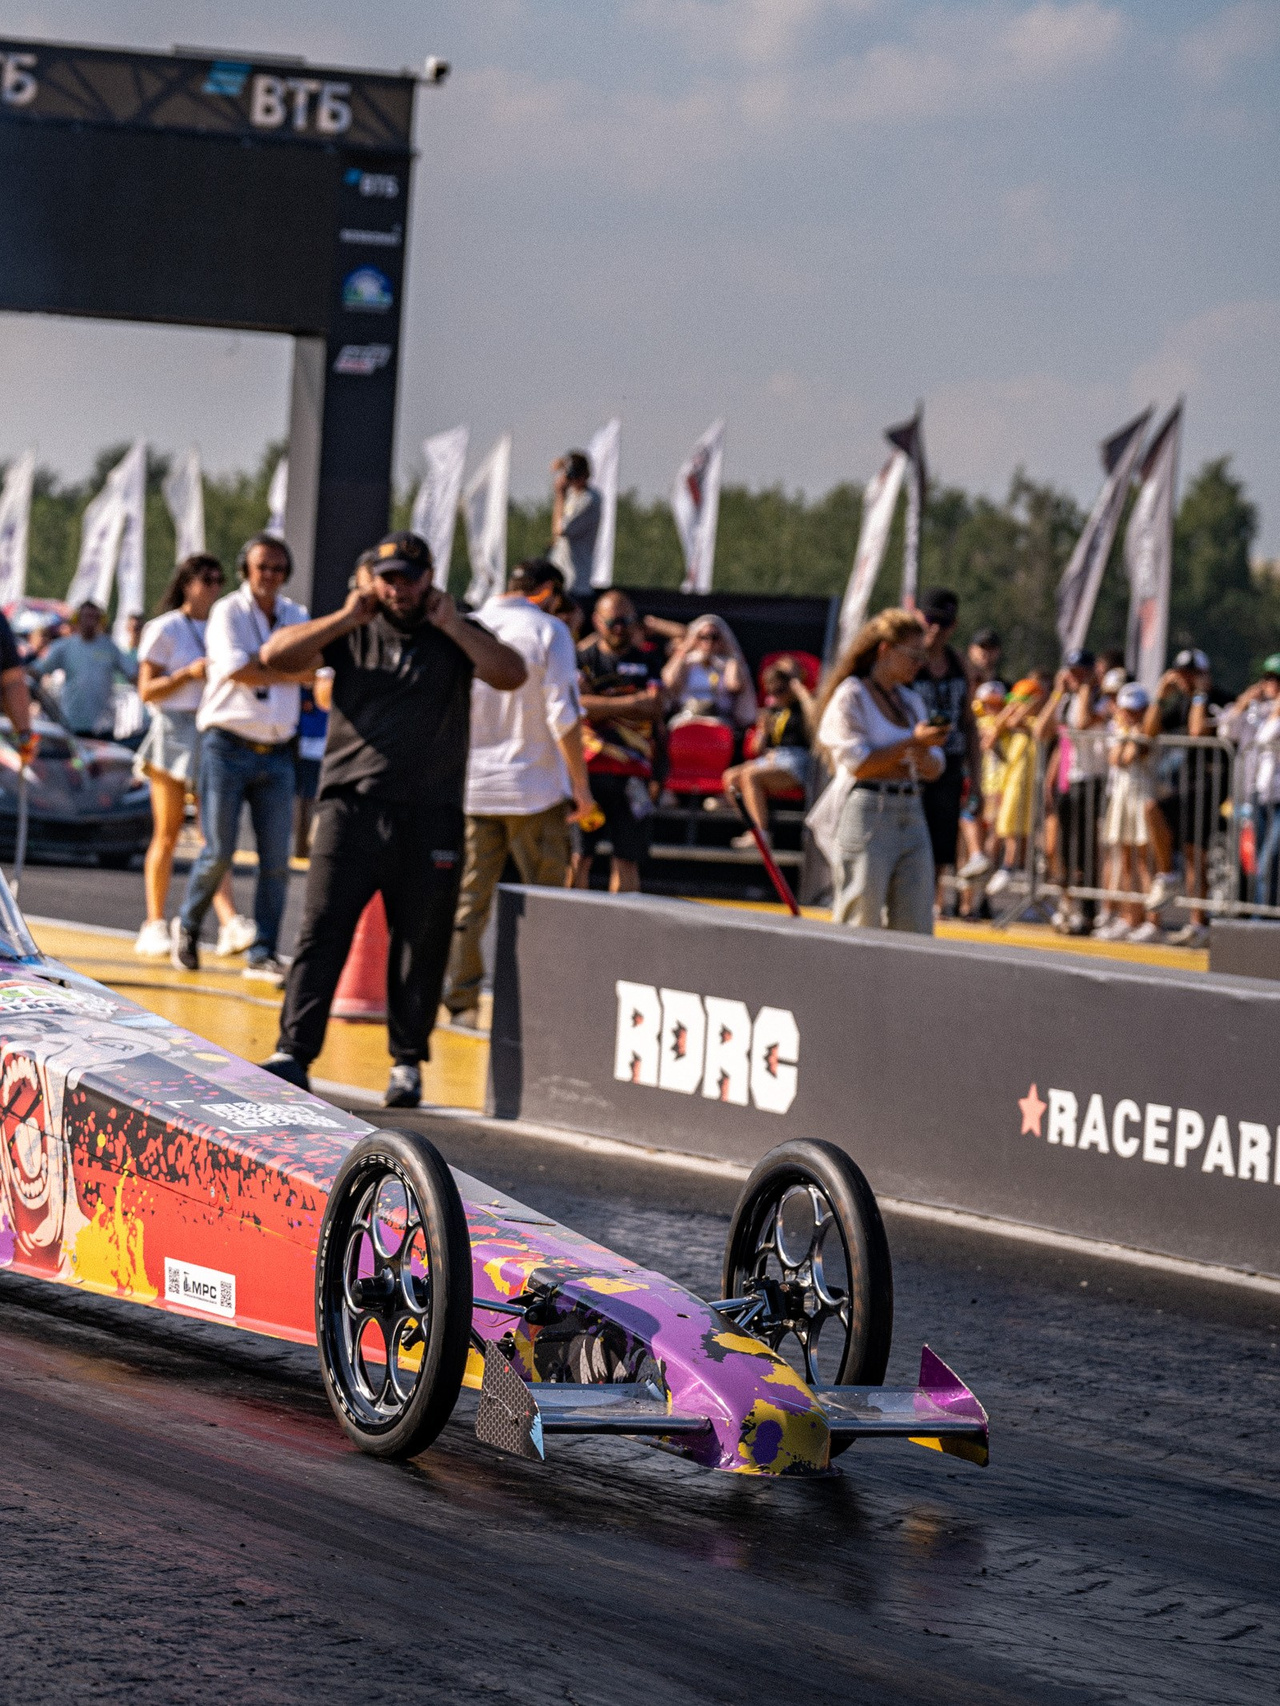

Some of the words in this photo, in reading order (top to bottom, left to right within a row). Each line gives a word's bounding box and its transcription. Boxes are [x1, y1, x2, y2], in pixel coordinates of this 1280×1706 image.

[250, 75, 352, 134] ВТБ
[614, 979, 801, 1115] RDRC
[1046, 1087, 1280, 1186] RACEPAR
[192, 1280, 217, 1299] MPC
